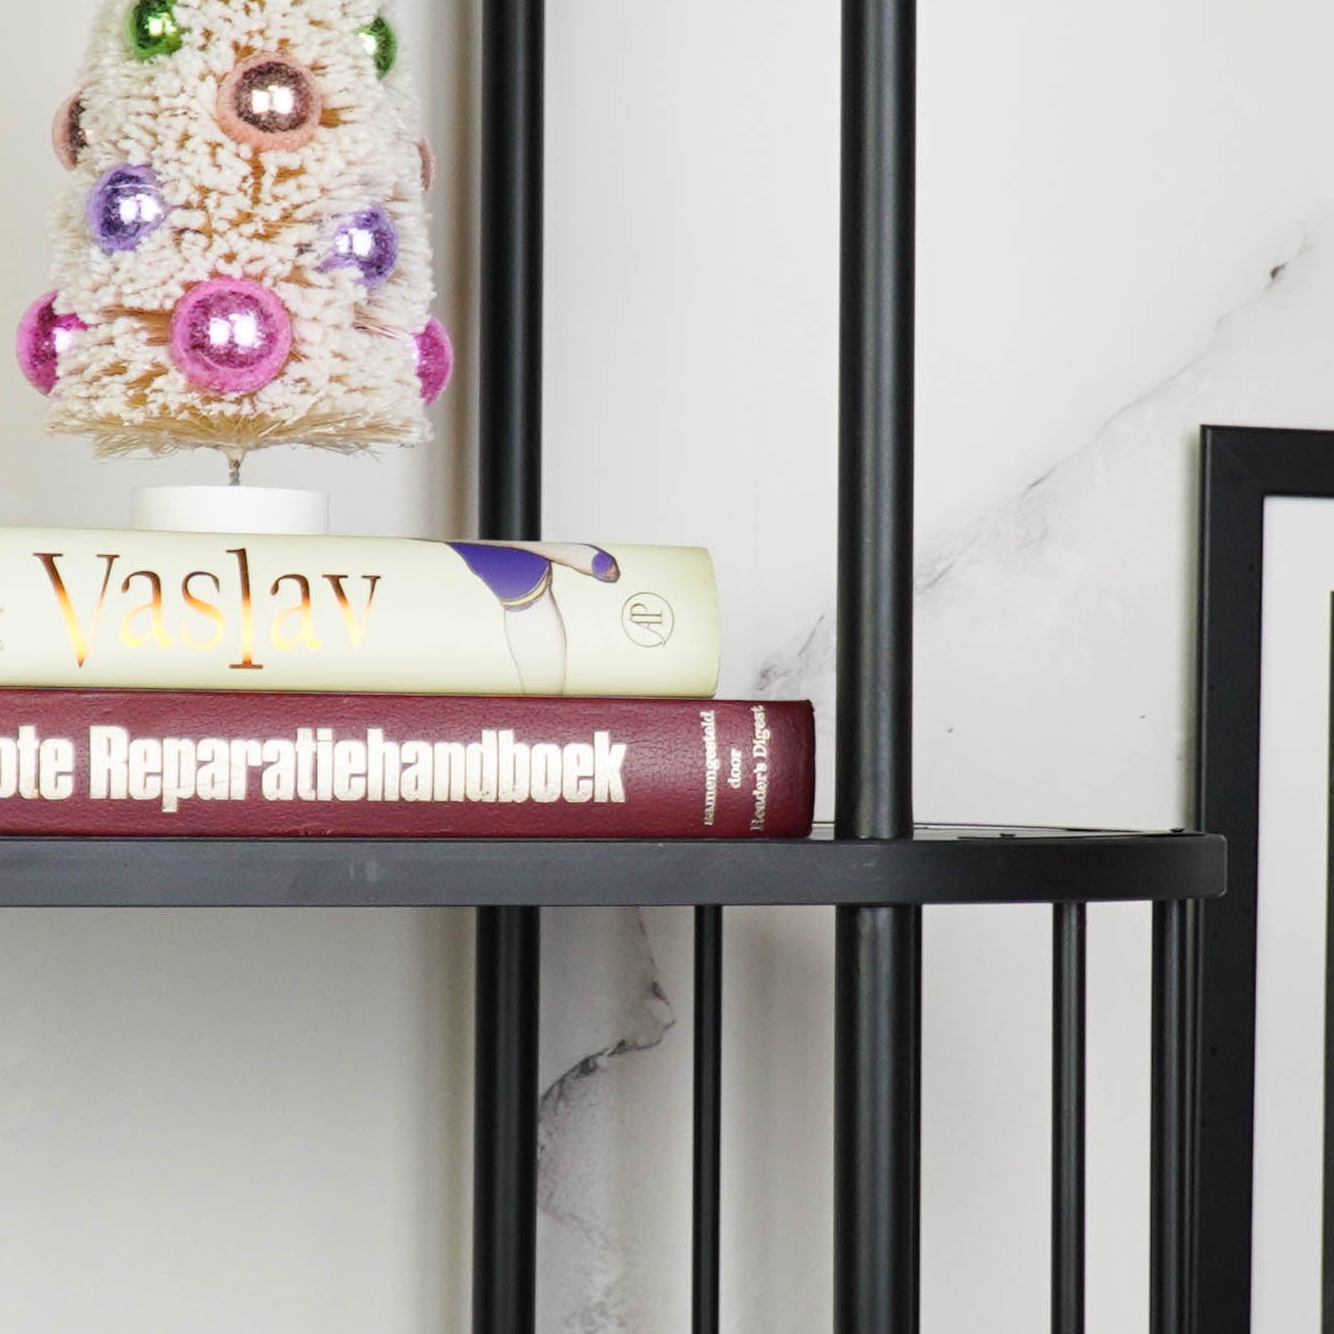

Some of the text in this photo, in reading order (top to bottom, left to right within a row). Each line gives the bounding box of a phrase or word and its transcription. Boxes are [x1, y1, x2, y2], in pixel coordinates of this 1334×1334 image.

[32, 547, 382, 670] Vaslav
[89, 725, 627, 812] Reparatiehandboek
[726, 748, 743, 789] door
[749, 705, 771, 831] Reader's Digest
